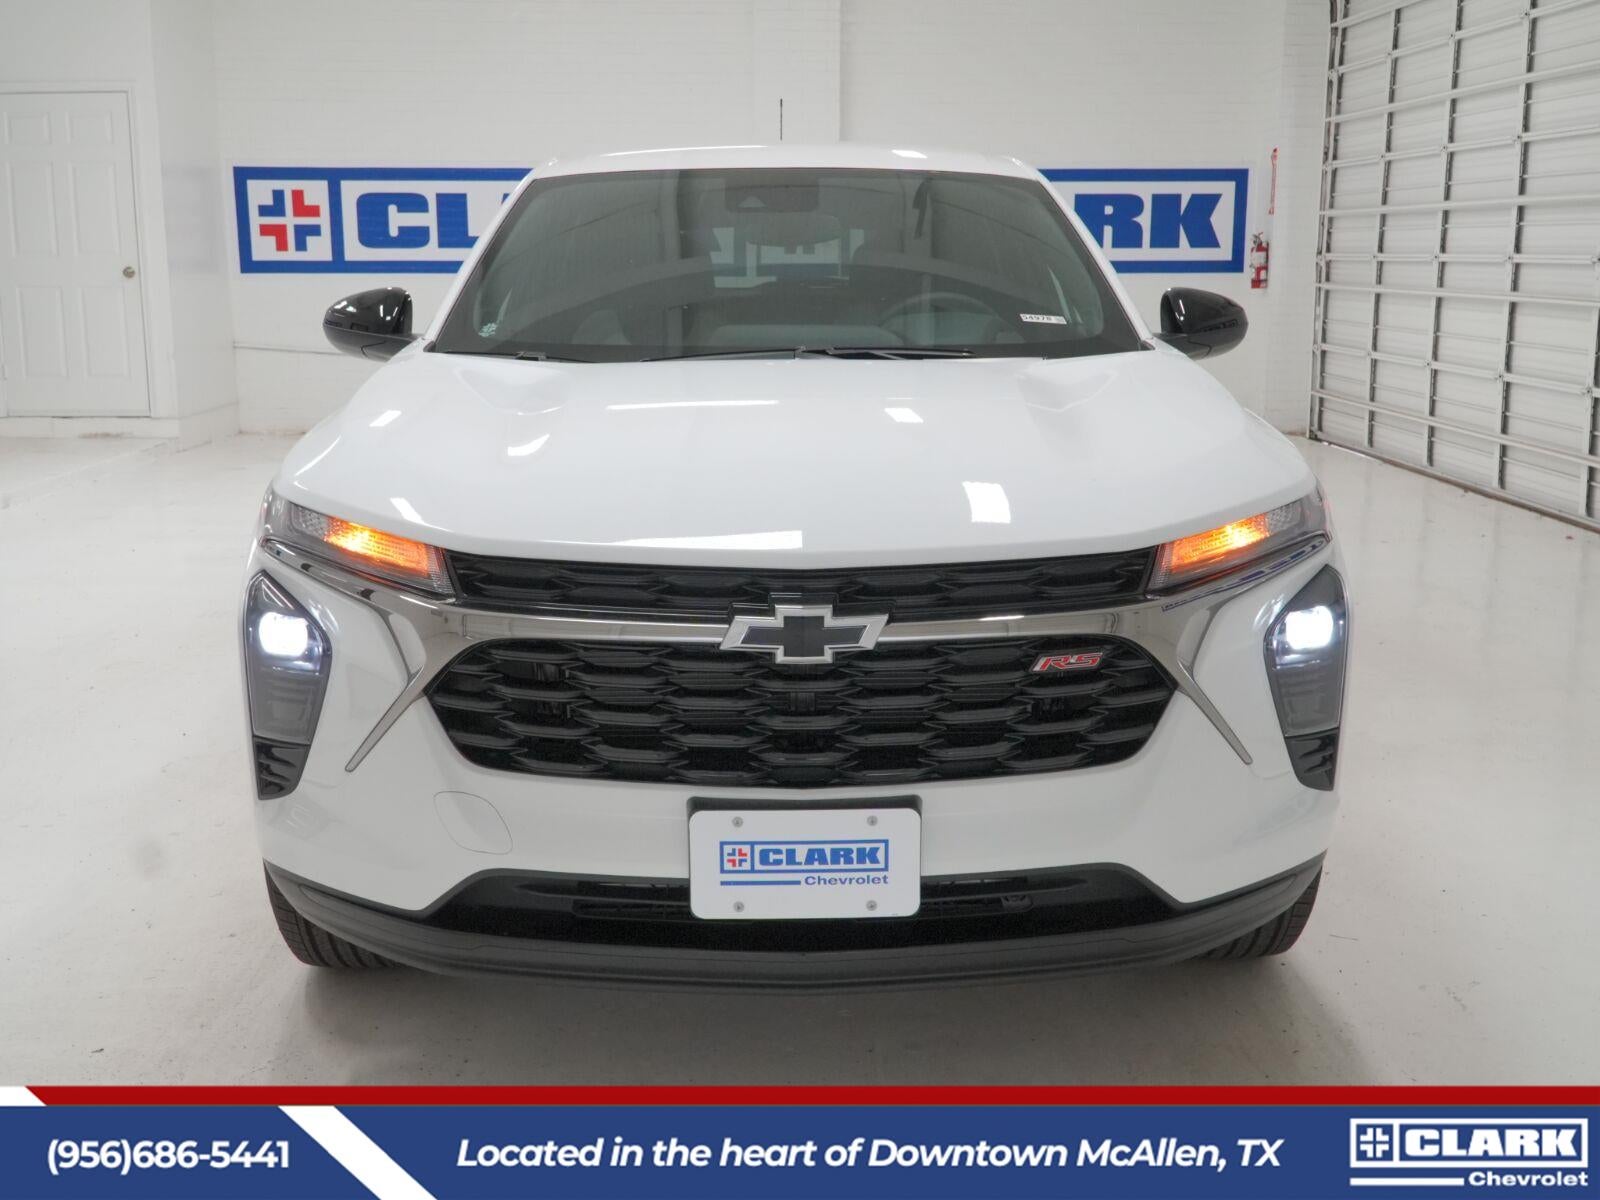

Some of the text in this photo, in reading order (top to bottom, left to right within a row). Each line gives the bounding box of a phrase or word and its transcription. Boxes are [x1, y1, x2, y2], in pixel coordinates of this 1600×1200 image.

[356, 193, 510, 248] CL
[1032, 652, 1103, 672] RS
[759, 847, 881, 866] CLARK
[804, 875, 889, 886] Chevrolet
